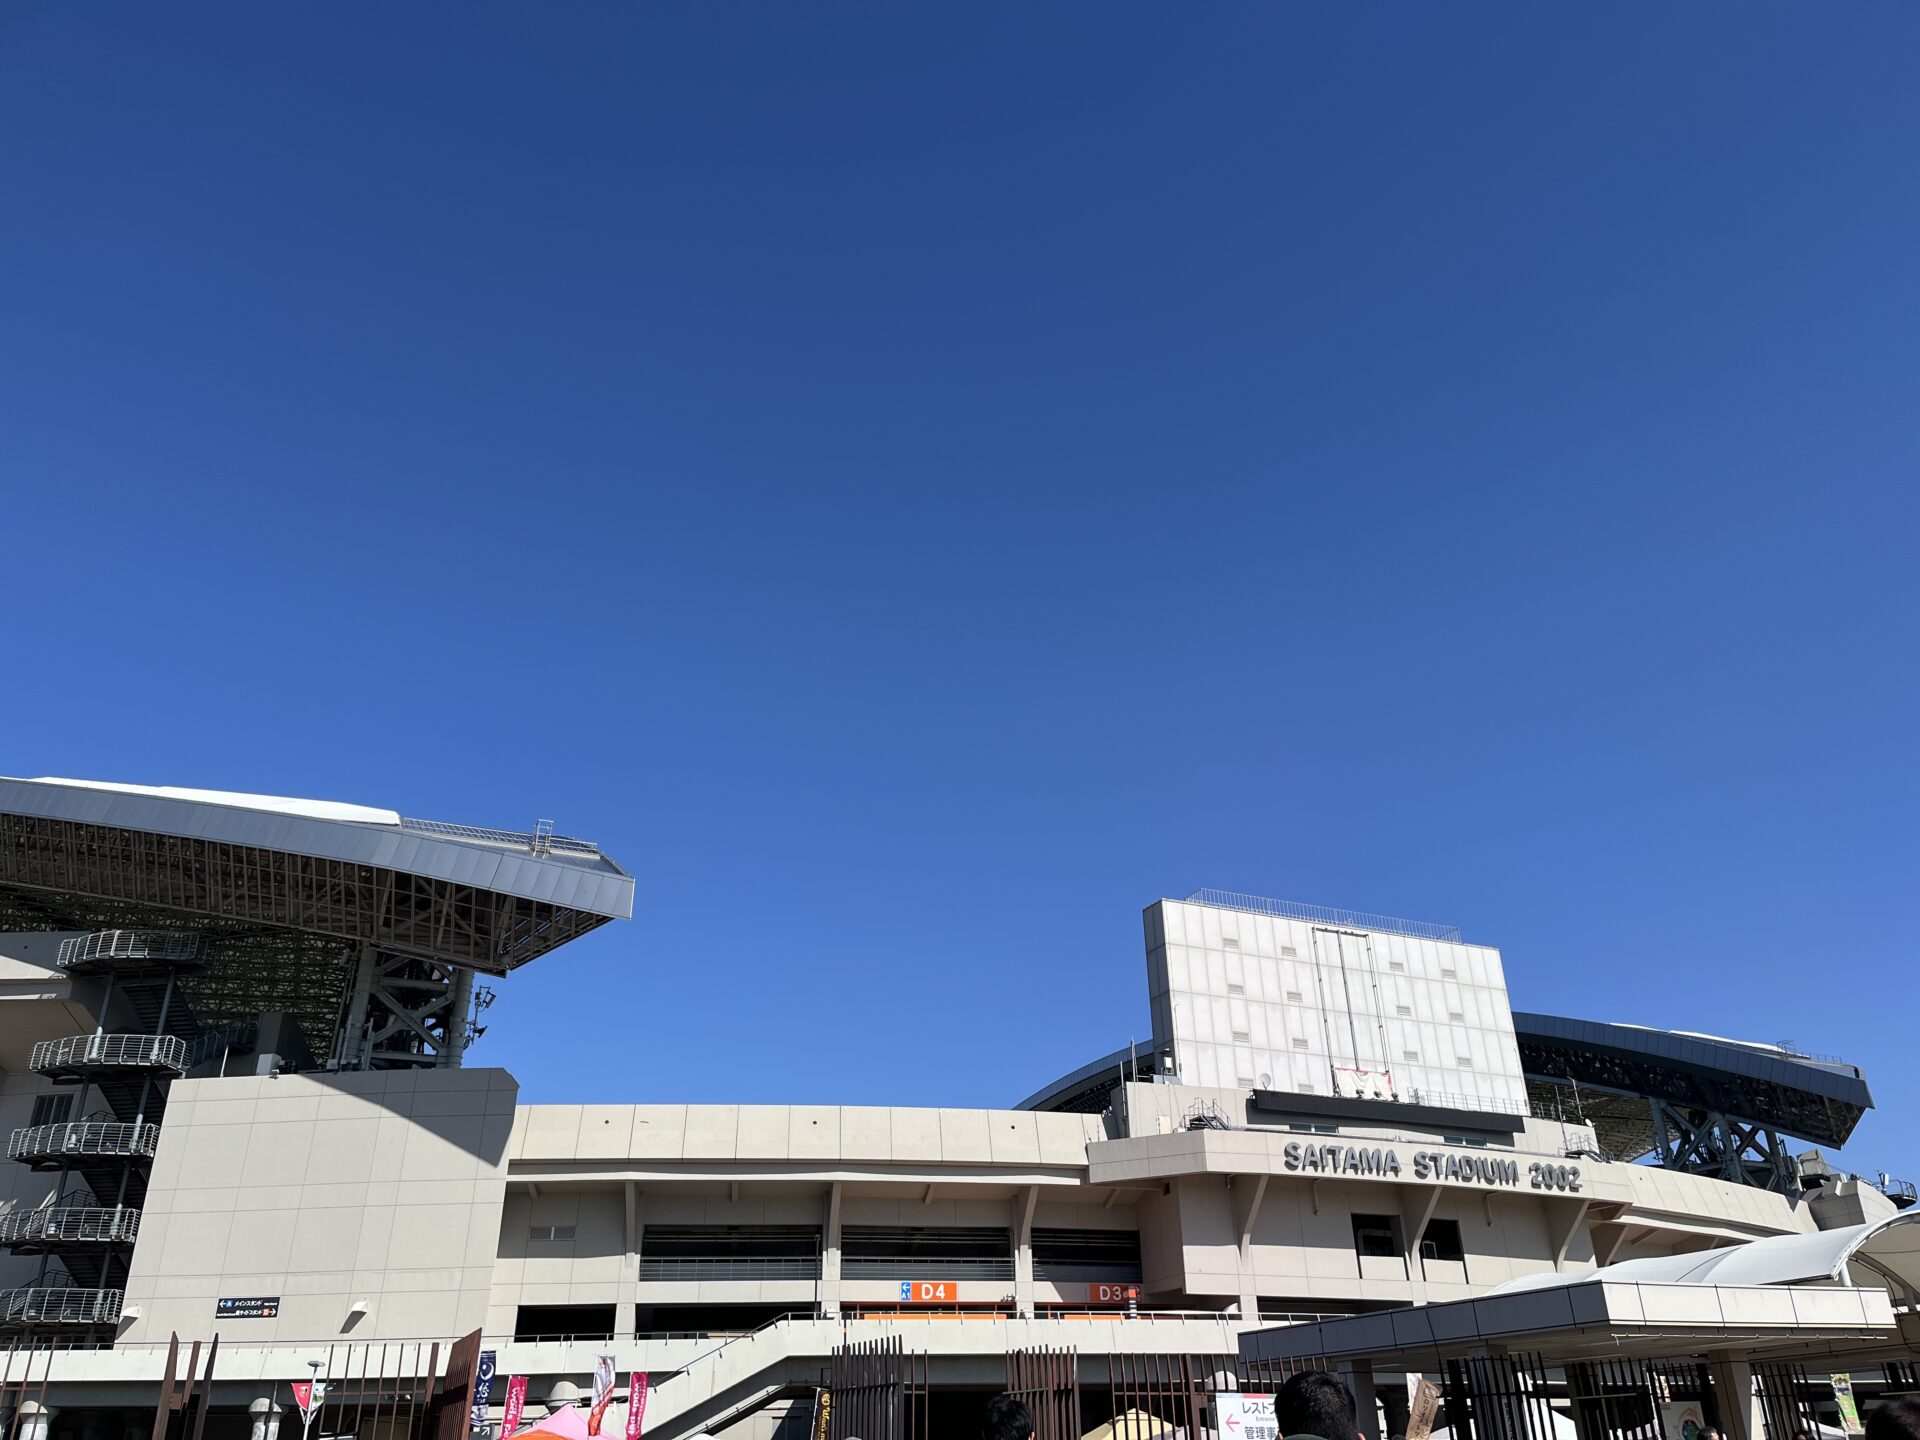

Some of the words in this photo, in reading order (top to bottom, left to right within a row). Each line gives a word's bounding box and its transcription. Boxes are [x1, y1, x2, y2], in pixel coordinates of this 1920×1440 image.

[1284, 1141, 1402, 1177] SAITAMA
[1414, 1151, 1520, 1187] STADIUM
[1529, 1162, 1583, 1193] 2002
[901, 1292, 910, 1300] A1
[921, 1283, 946, 1300] D4
[1099, 1285, 1122, 1301] D3
[1244, 1426, 1280, 1440] 管理事
